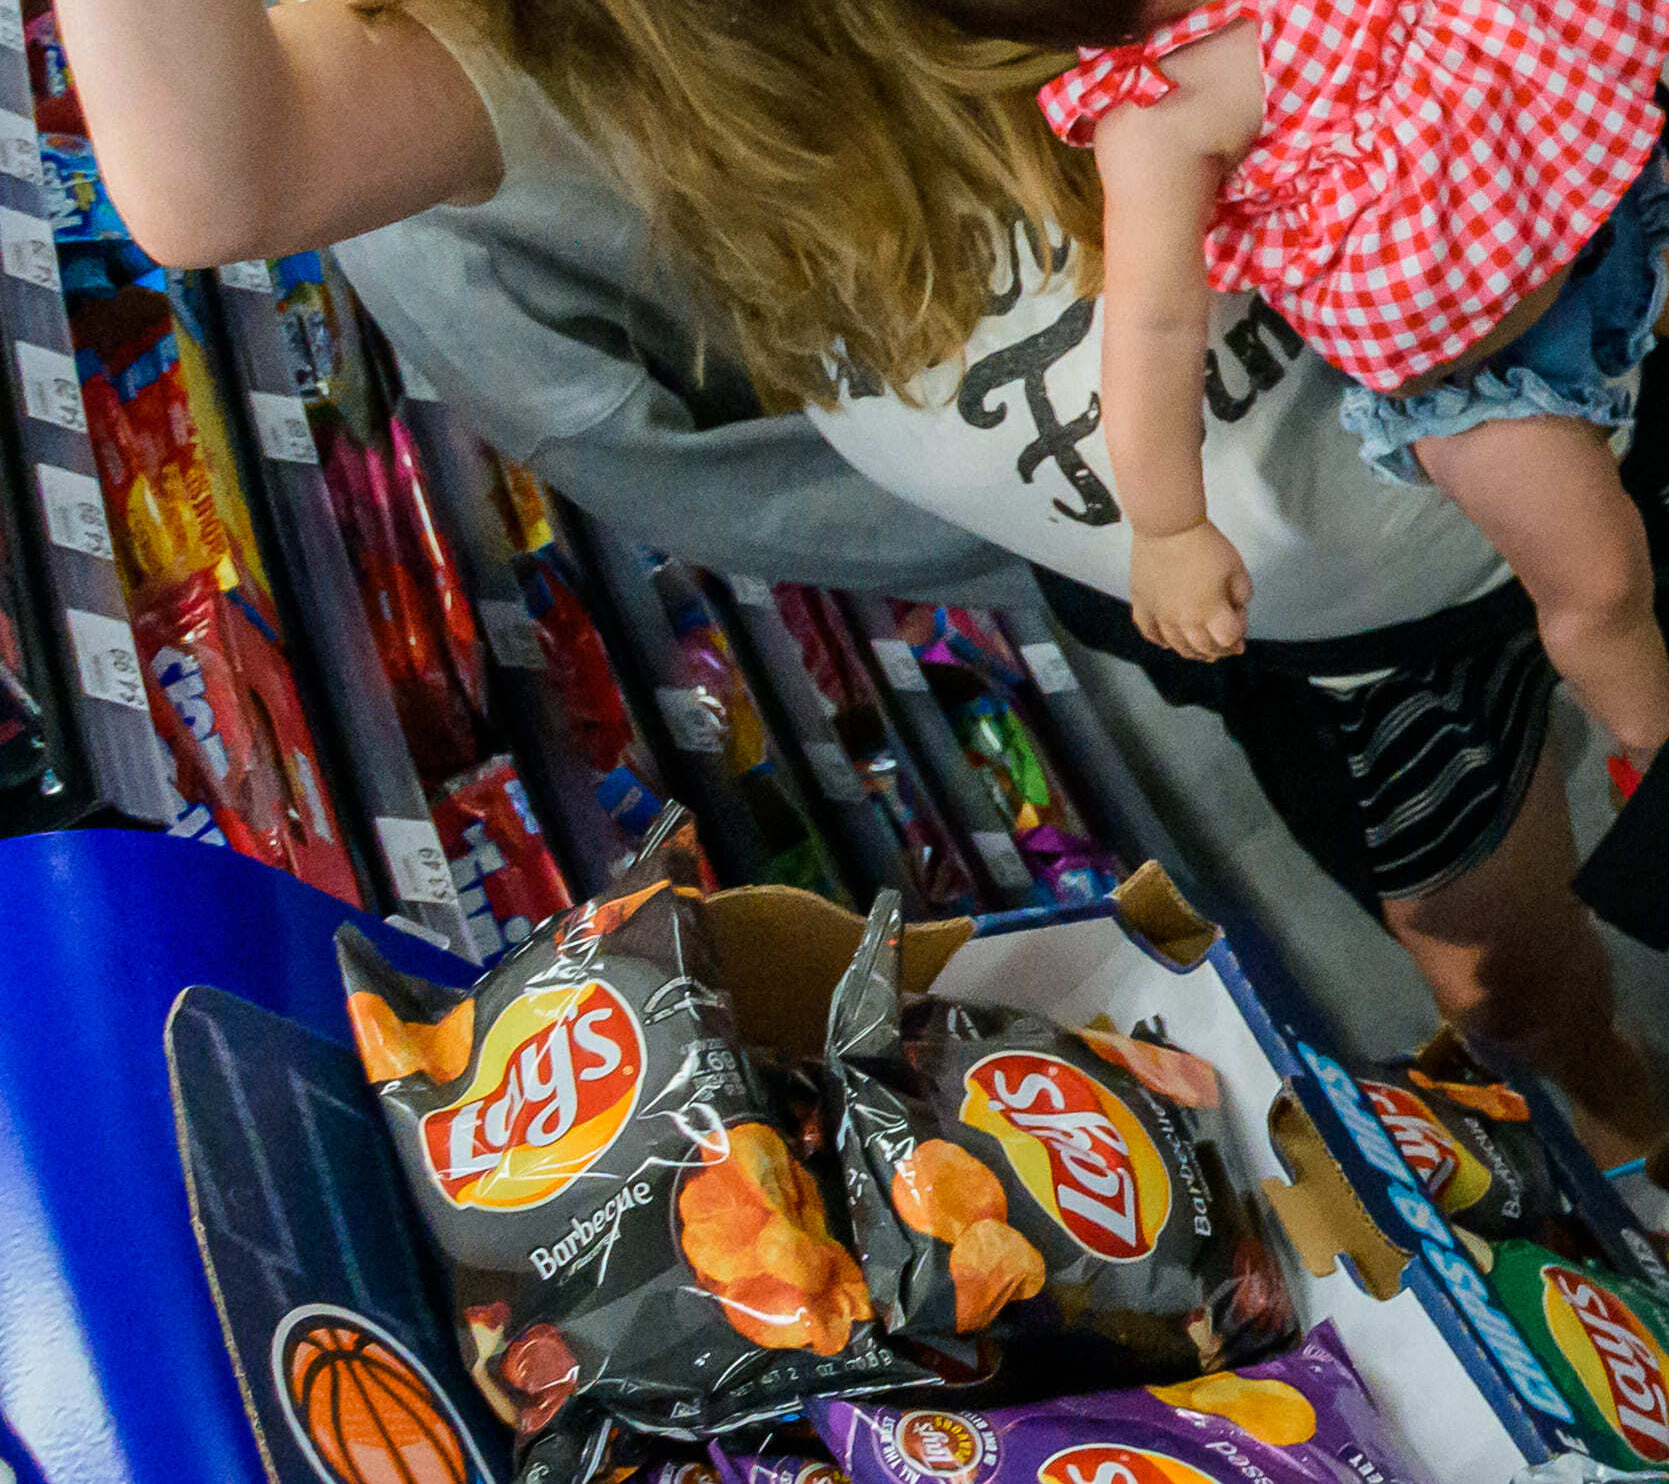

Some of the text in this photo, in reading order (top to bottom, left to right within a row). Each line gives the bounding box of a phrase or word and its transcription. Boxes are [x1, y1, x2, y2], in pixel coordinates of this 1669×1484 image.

[418, 845, 448, 902] $3.49
[445, 1003, 623, 1182] Lay's
[995, 1067, 1140, 1247] Lay's
[527, 1179, 655, 1283] Barbecue
[1560, 1272, 1669, 1450] Lay's
